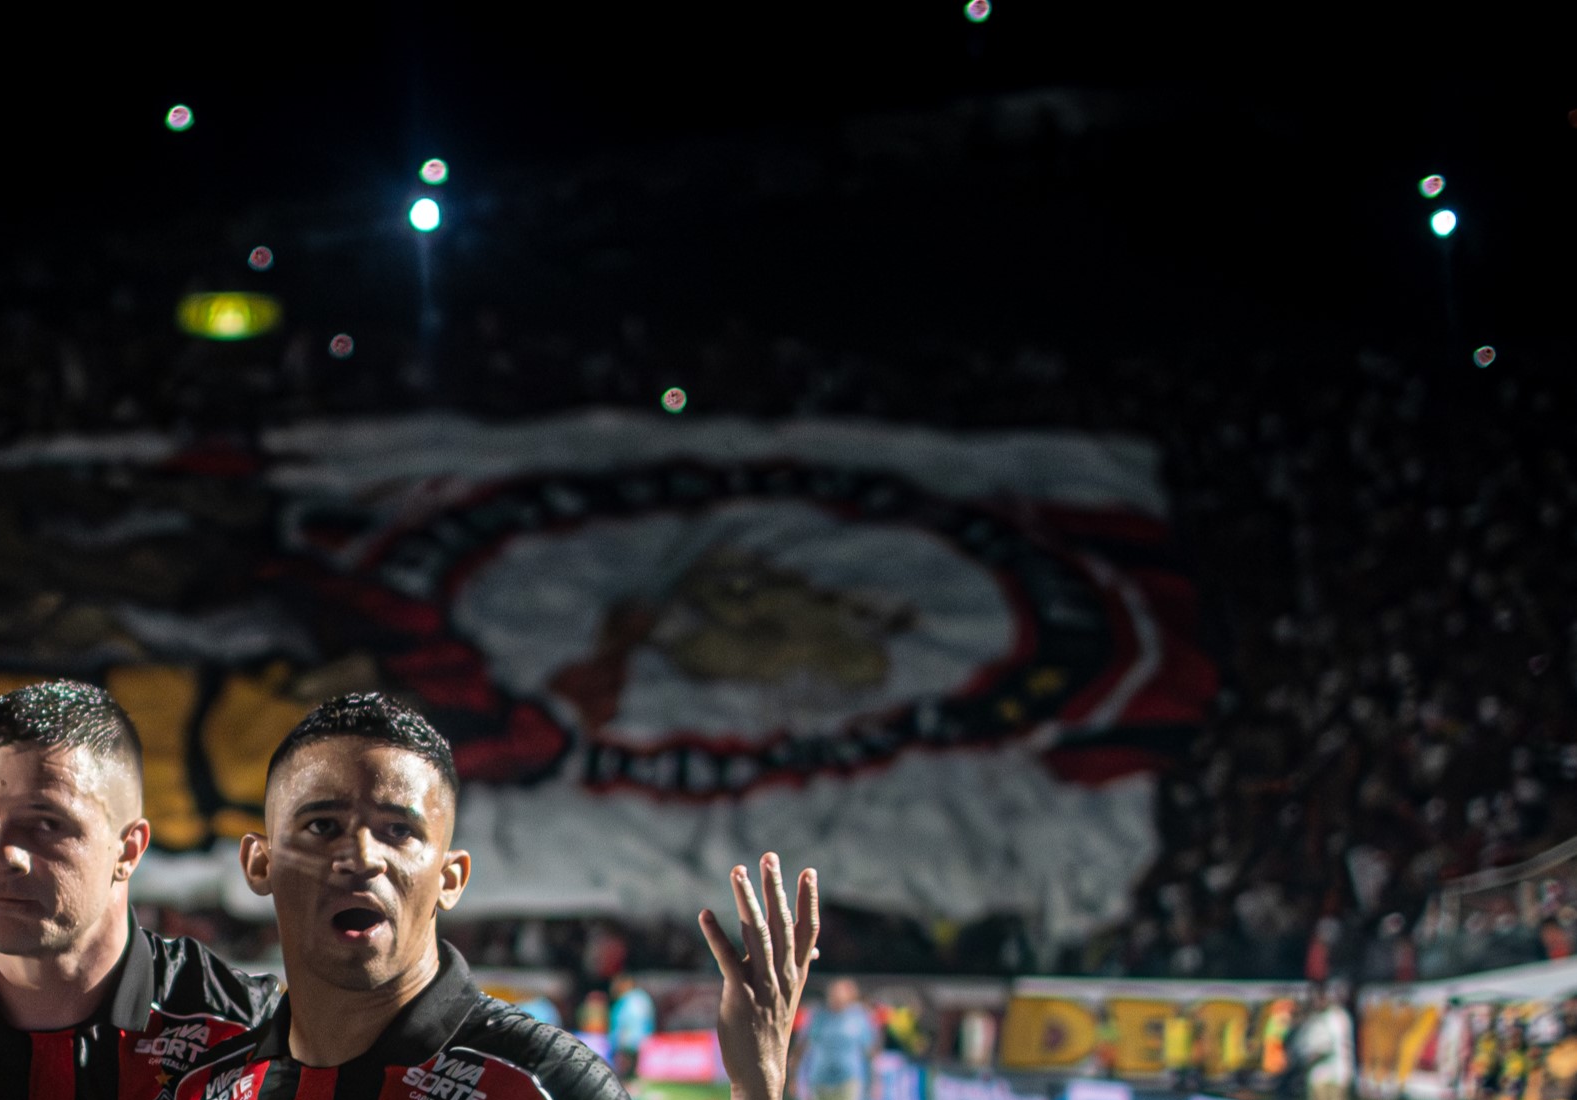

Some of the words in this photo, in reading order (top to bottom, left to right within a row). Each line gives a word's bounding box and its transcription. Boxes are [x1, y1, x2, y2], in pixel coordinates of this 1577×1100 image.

[134, 1037, 209, 1064] SORT
[205, 1066, 245, 1100] VIVA
[431, 1052, 486, 1086] VIVA
